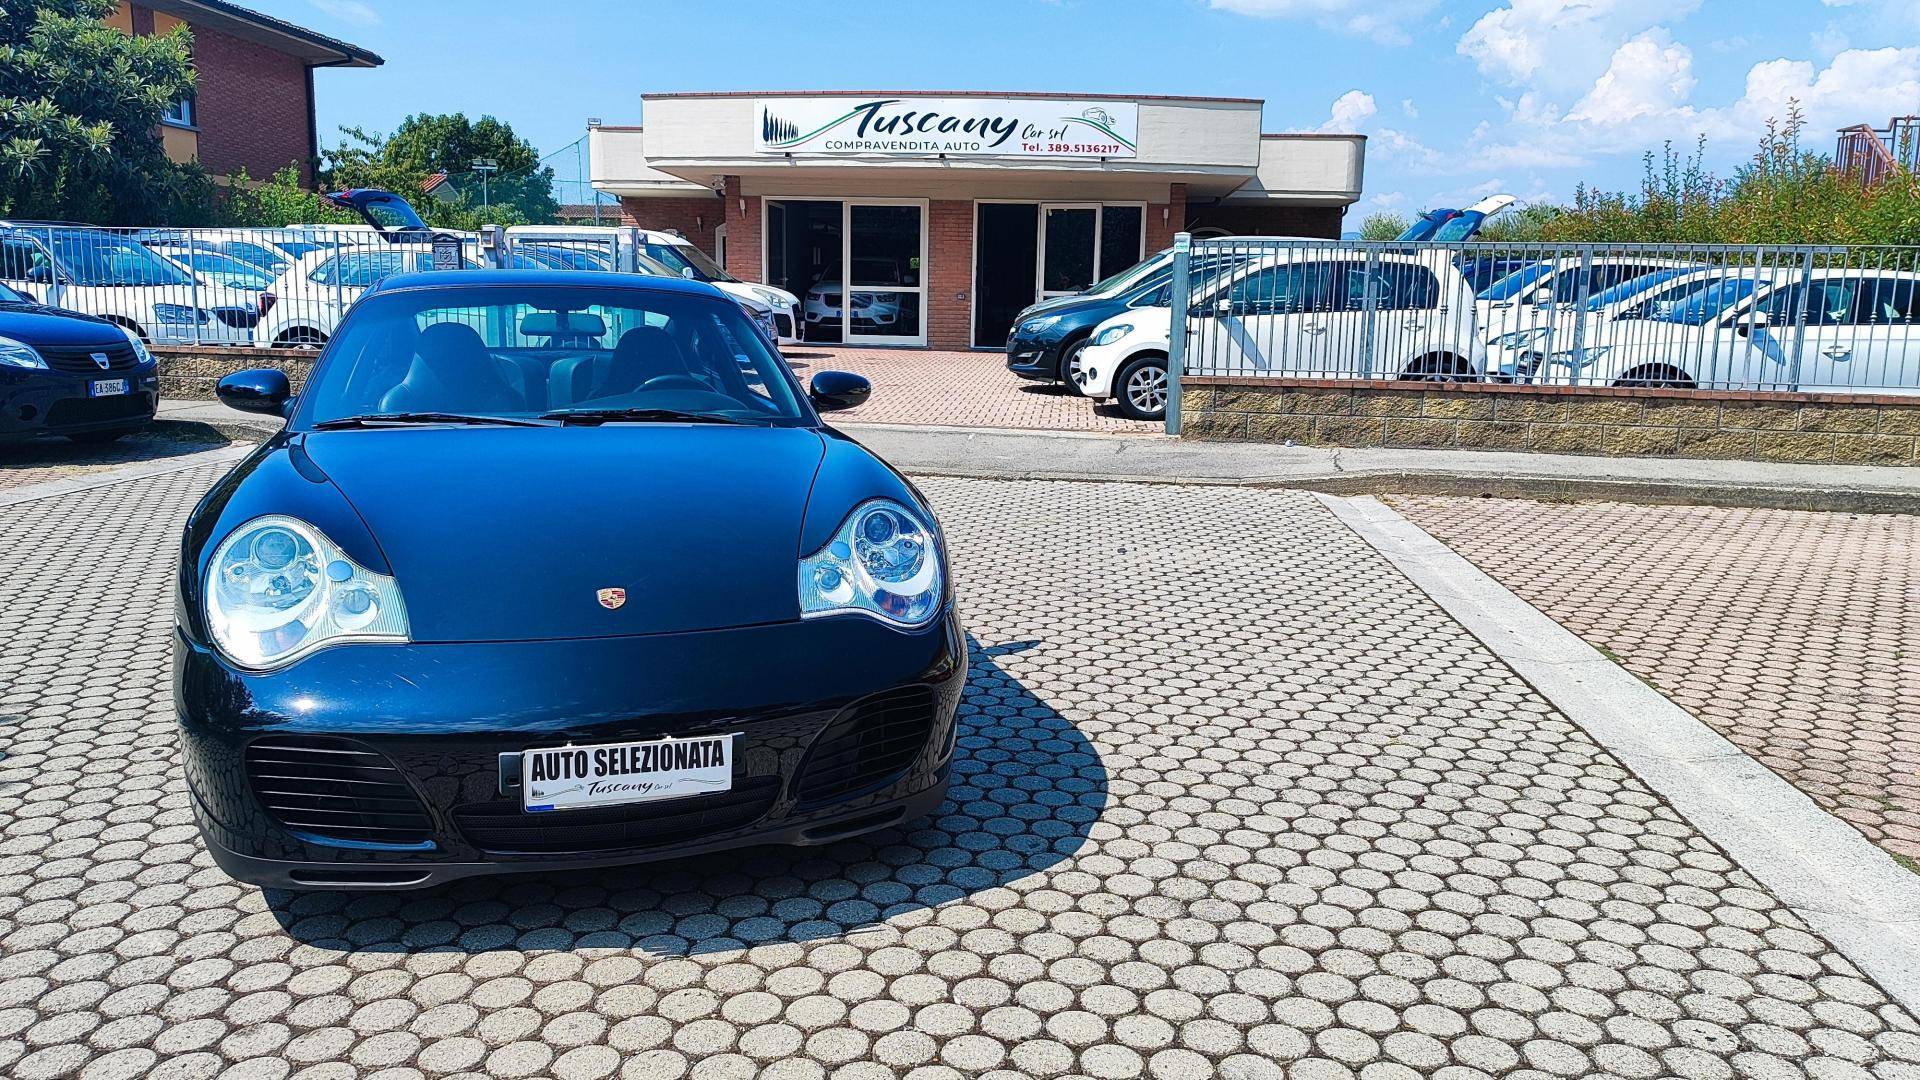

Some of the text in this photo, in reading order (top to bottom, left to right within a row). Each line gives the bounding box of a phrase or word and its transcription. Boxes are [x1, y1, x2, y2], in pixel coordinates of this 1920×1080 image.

[854, 100, 1069, 148] Tuscany Car srl
[825, 140, 980, 151] COMPRAVENDITA AUTO
[1021, 143, 1120, 153] Tel. 389.5136217
[531, 740, 725, 781] AUTO SELEZIONATA
[588, 780, 653, 796] Tuscany
